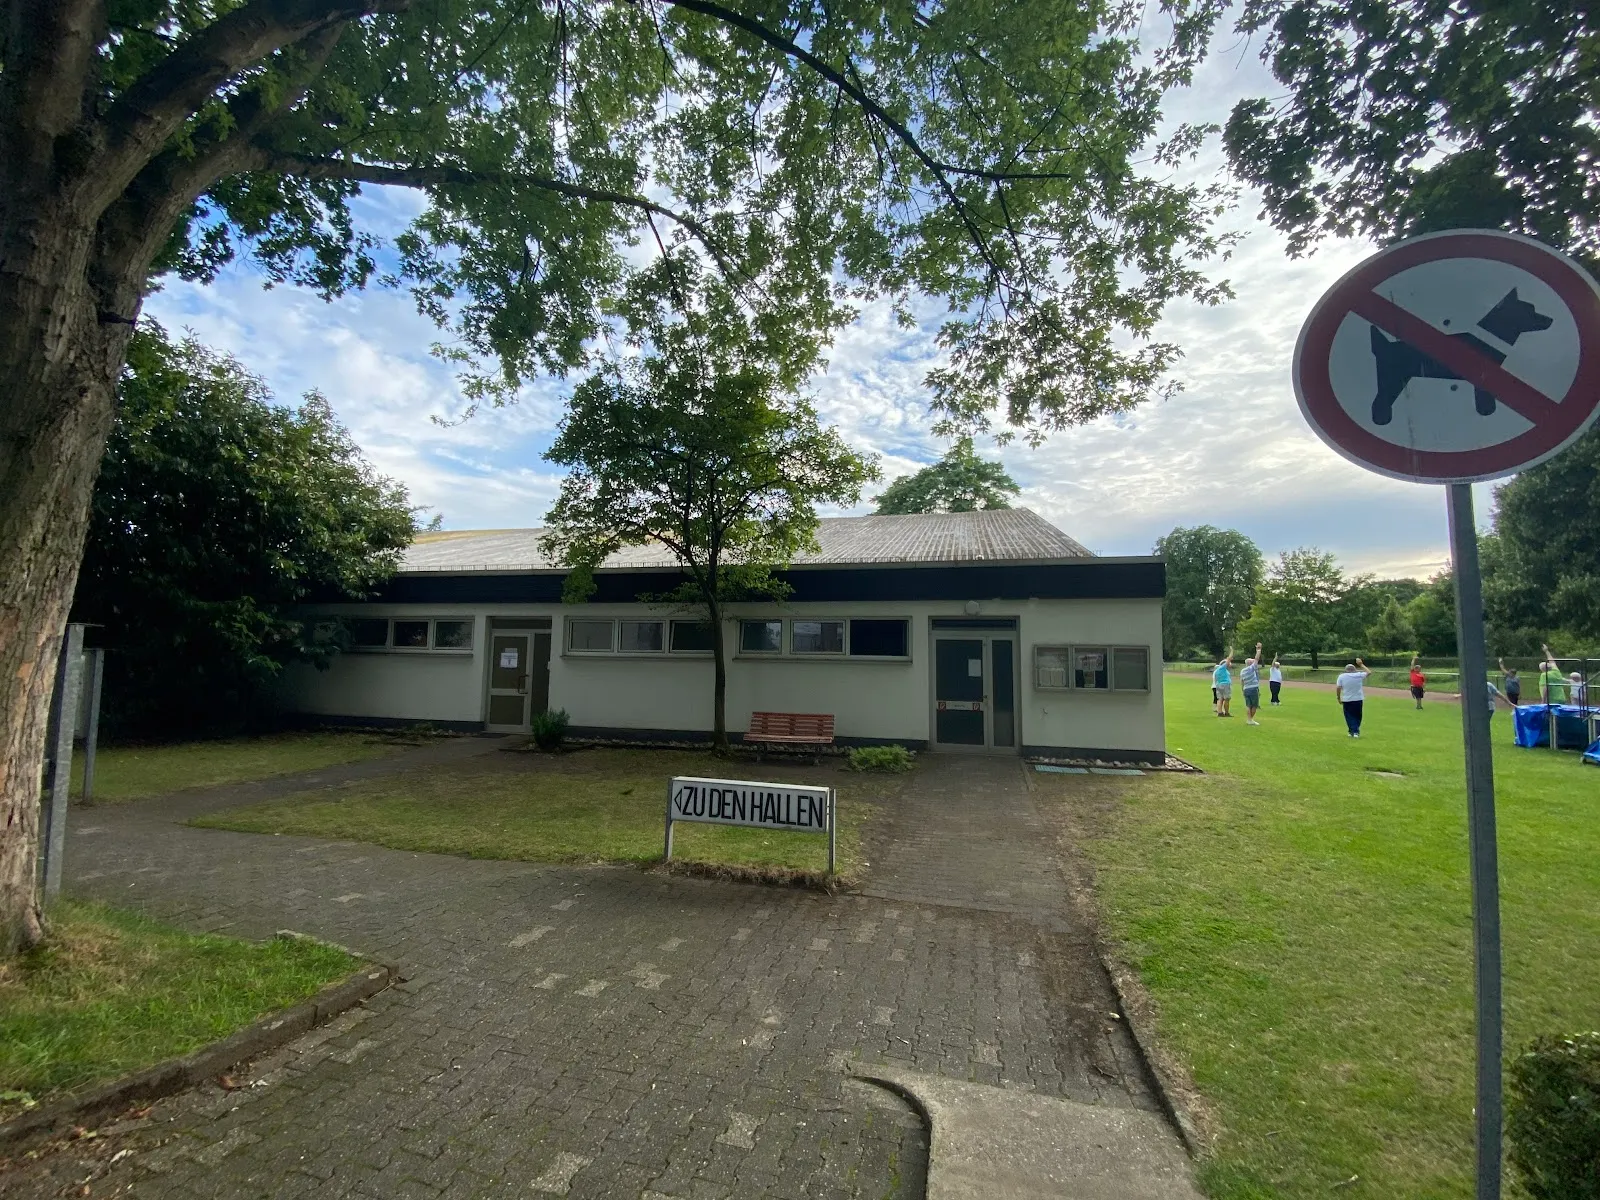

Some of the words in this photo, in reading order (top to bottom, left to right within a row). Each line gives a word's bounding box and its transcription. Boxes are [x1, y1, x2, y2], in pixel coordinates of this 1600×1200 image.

[682, 786, 706, 816] ZU
[709, 788, 746, 821] DEN
[750, 791, 823, 828] HALLEN
